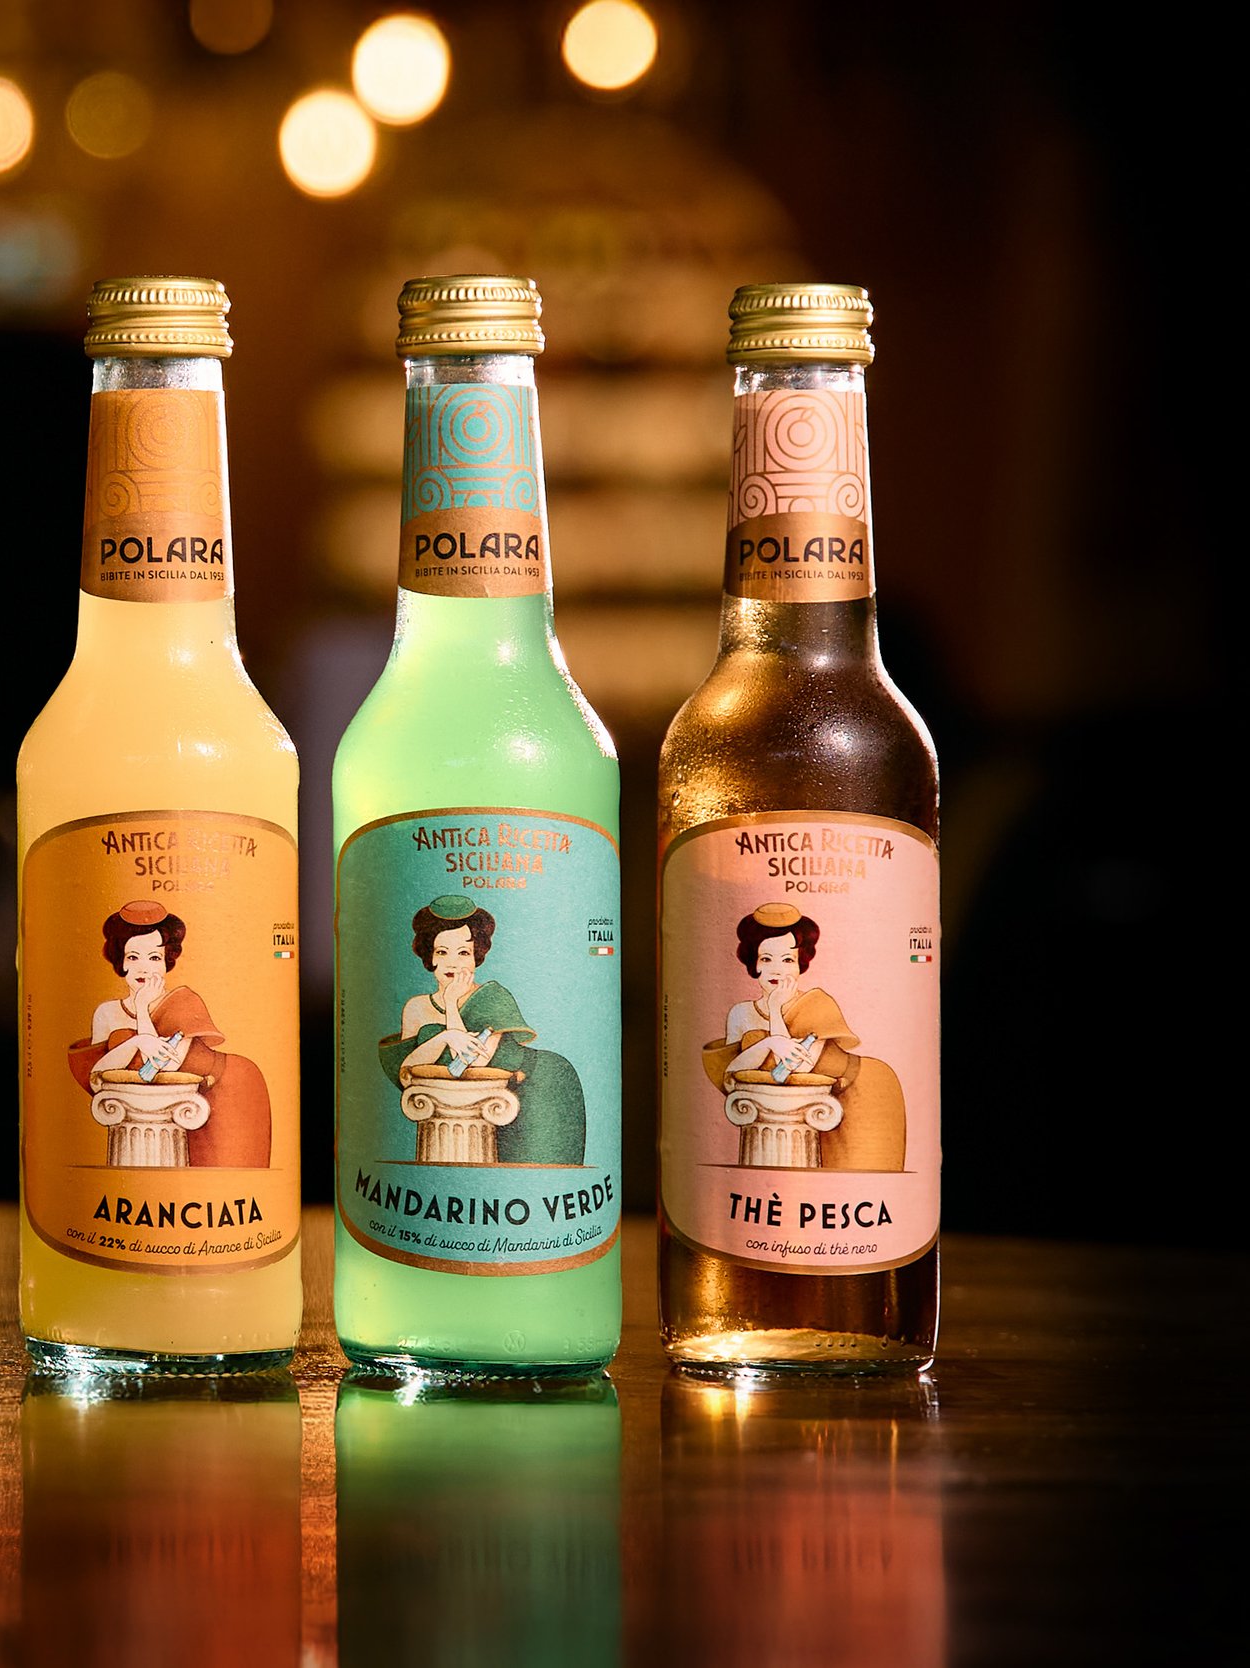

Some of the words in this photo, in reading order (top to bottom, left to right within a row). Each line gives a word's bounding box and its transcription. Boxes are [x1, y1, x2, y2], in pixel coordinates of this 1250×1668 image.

[100, 536, 224, 565] POLARA
[415, 532, 539, 561] POLARA
[739, 536, 864, 565] POLARA
[100, 570, 131, 582] BIBITE
[133, 570, 145, 580] IN
[148, 570, 187, 580] SICILIA
[189, 570, 208, 580] DAL
[209, 571, 225, 581] 1953
[415, 566, 444, 578] BIBITE
[446, 566, 458, 576] IN
[461, 565, 500, 575] SICILIA
[503, 566, 522, 576] DAL
[524, 566, 539, 578] 1953
[770, 570, 782, 580] IN
[784, 569, 824, 579] SICILIA
[827, 570, 846, 580] DAL
[848, 570, 864, 581] 1953
[101, 830, 178, 855] ANTICA
[412, 826, 490, 851] ANTICA
[497, 822, 573, 855] RICETTA
[735, 831, 814, 856] ANTICA
[821, 828, 895, 860] RICETTA
[445, 851, 544, 875] SICILIANA
[768, 856, 867, 880] SICILIANA
[462, 876, 527, 889] POLARA
[785, 880, 849, 894] POLARA
[273, 934, 295, 946] ITALIA
[588, 930, 614, 942] ITALIA
[909, 938, 932, 950] ITALIA
[355, 1167, 530, 1226] MANDARINO
[542, 1174, 614, 1223] VERDE
[93, 1194, 263, 1229] ARANCIATA
[729, 1192, 783, 1227] THÈ
[799, 1199, 893, 1230] PESCA
[66, 1227, 85, 1241] con
[86, 1231, 97, 1245] il
[98, 1235, 126, 1250] 22%
[129, 1239, 143, 1253] di
[145, 1244, 180, 1255] succo
[182, 1241, 196, 1255] di
[197, 1240, 241, 1256] Arance
[243, 1235, 254, 1251] di
[255, 1228, 282, 1250] Sicilia
[369, 1219, 387, 1235] con
[388, 1224, 397, 1238] il
[398, 1229, 422, 1245] 15%
[424, 1232, 438, 1247] di
[439, 1238, 475, 1251] succo
[477, 1238, 491, 1252] di
[492, 1236, 561, 1254] Mandarini
[562, 1230, 574, 1246] di
[575, 1225, 603, 1246] Sicilia
[746, 1239, 769, 1251] con
[771, 1240, 811, 1258] infuso
[813, 1242, 827, 1255] di
[829, 1241, 849, 1255] thè
[850, 1243, 878, 1254] nero
